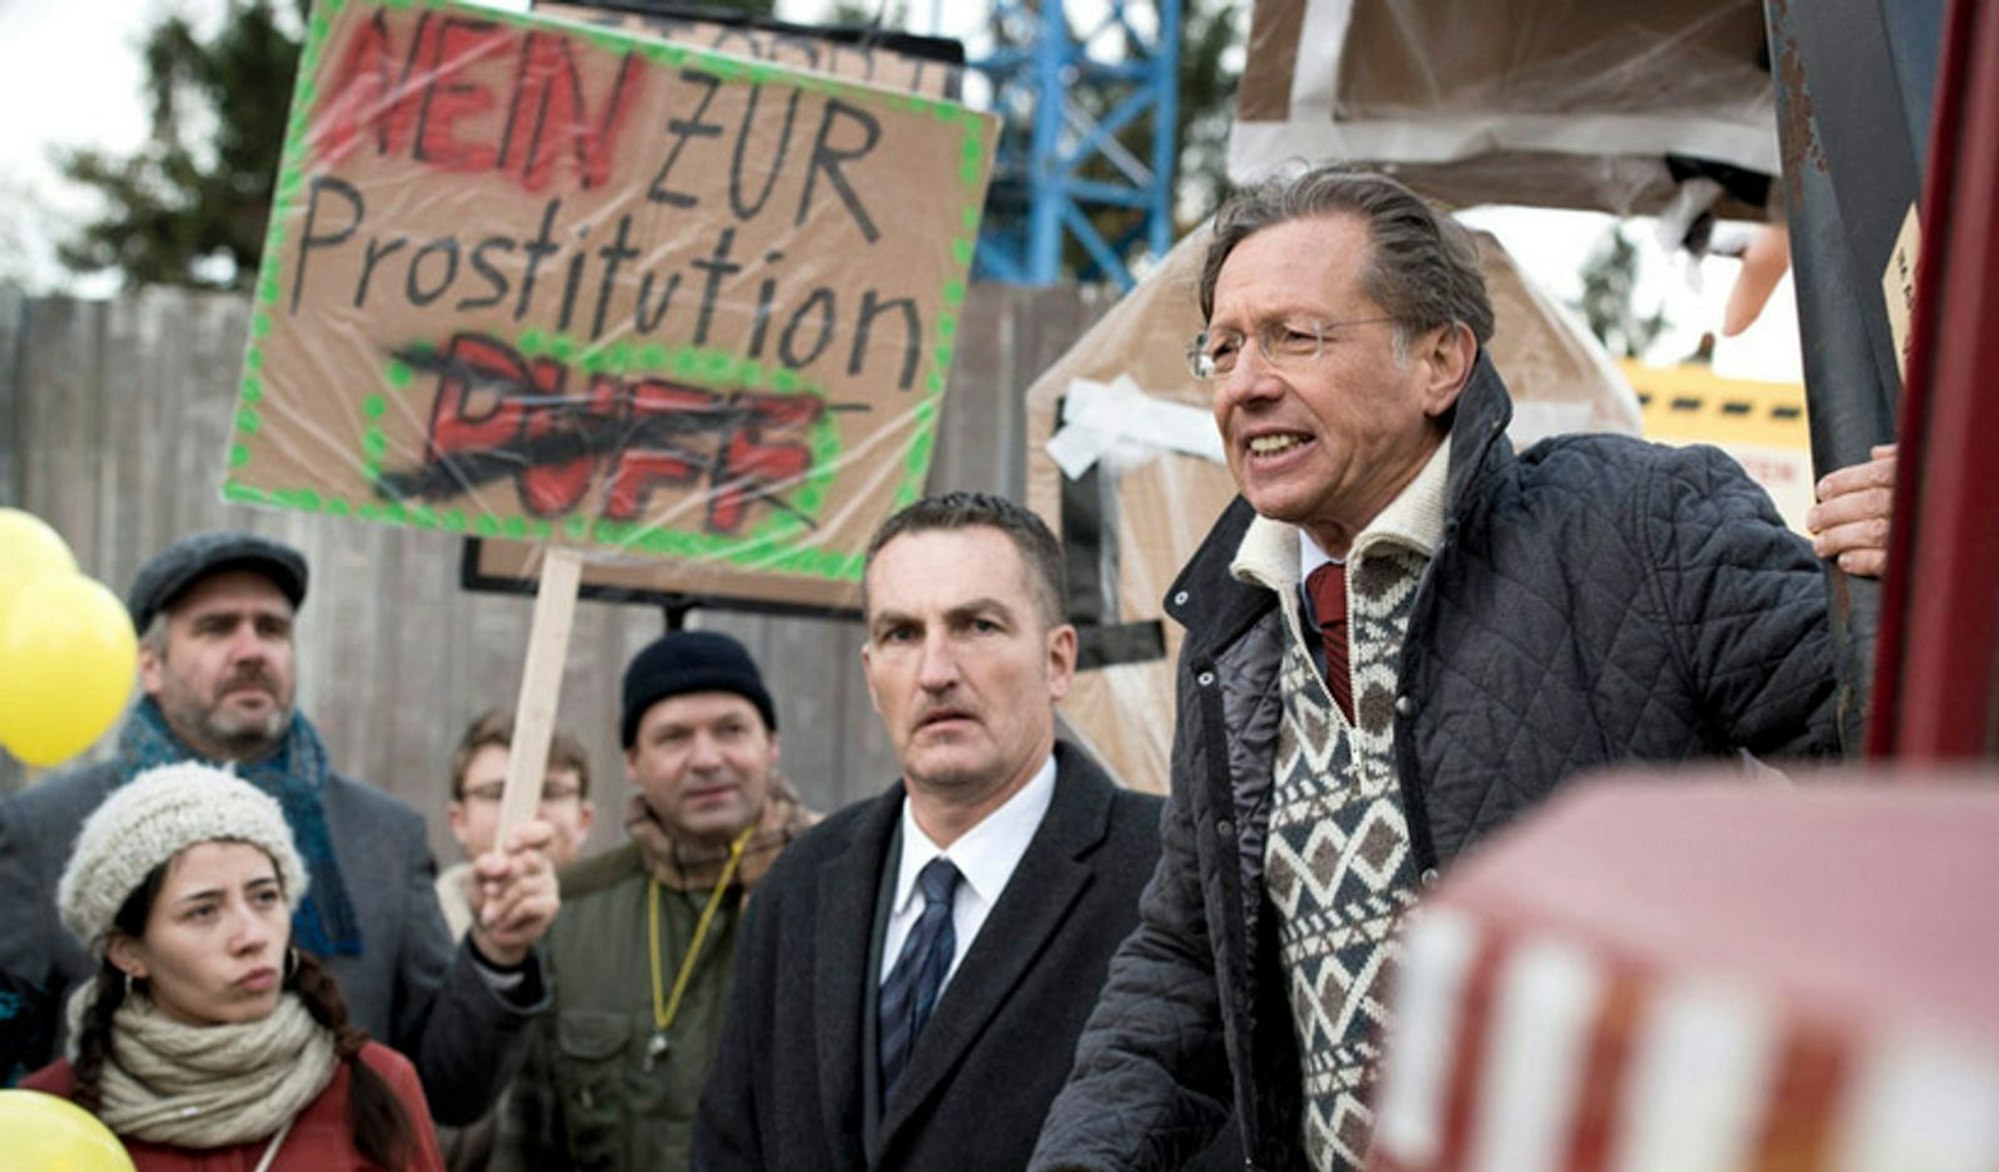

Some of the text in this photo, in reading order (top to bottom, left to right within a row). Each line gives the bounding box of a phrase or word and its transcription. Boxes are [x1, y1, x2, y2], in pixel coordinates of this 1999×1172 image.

[315, 8, 646, 192] NEIN
[645, 68, 881, 244] ZUR
[290, 174, 924, 391] Prostitution
